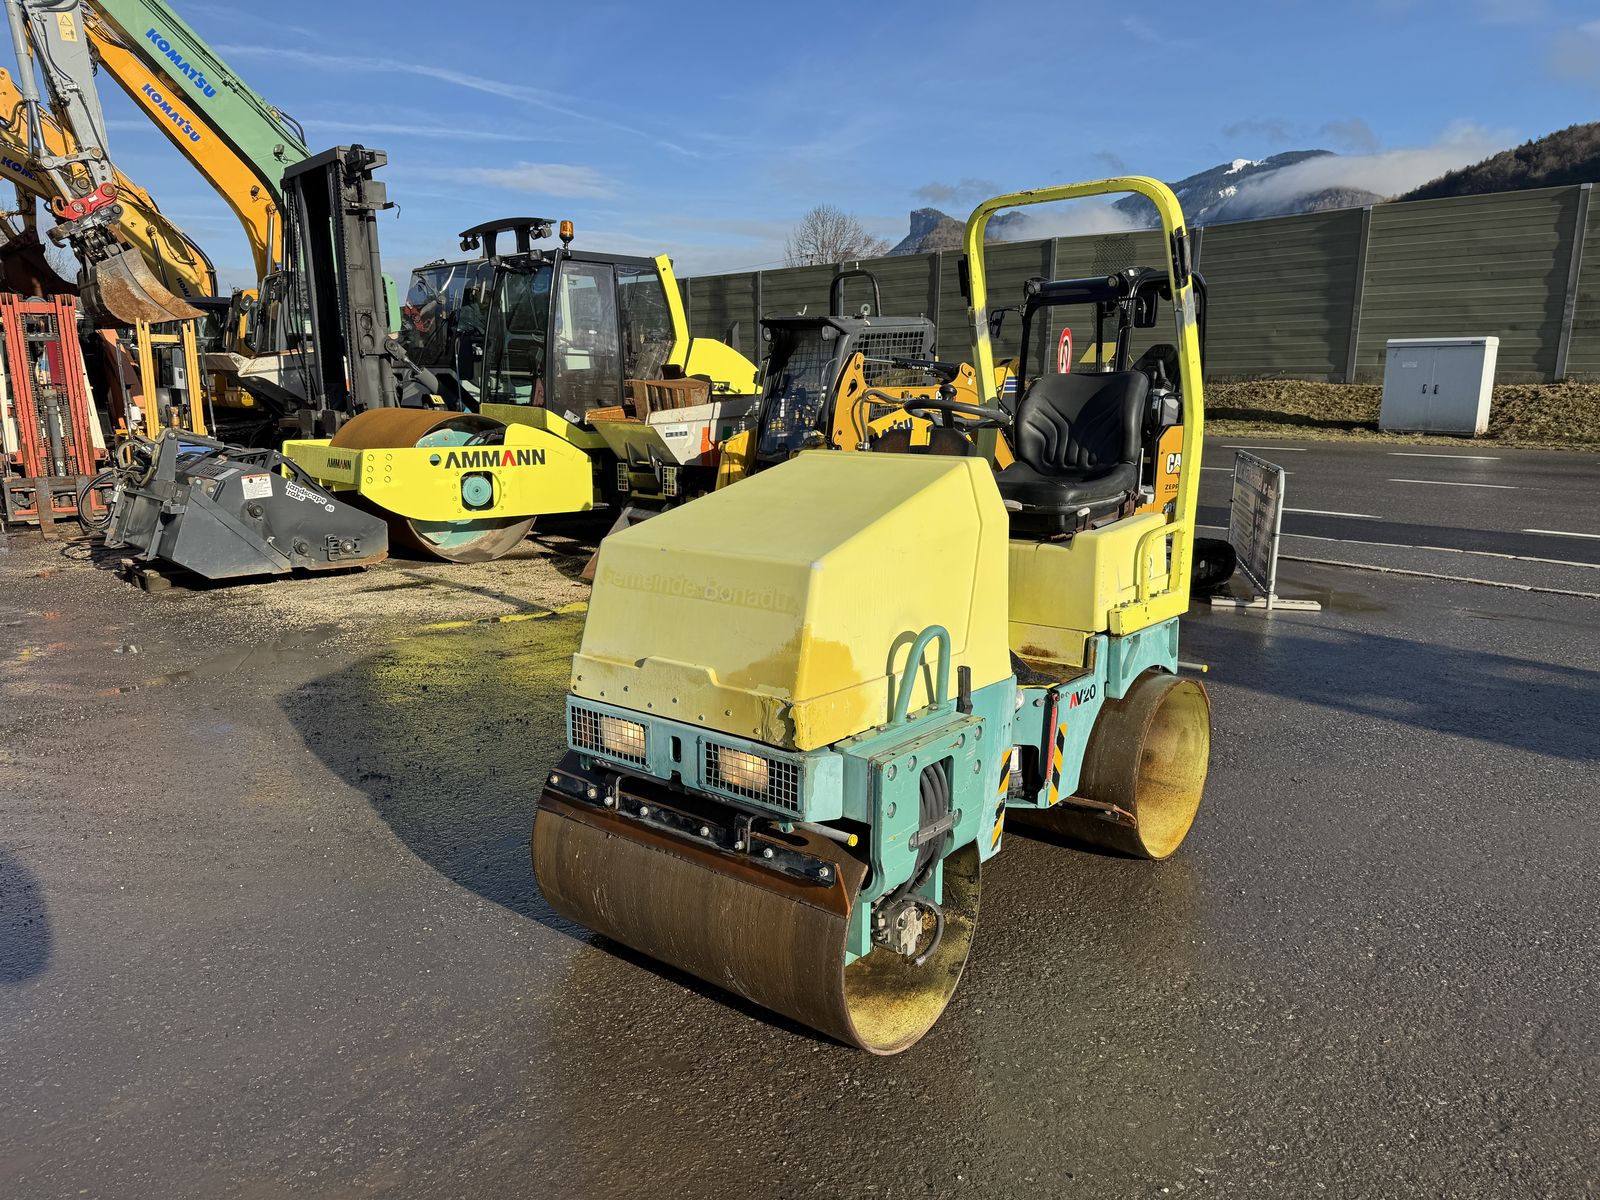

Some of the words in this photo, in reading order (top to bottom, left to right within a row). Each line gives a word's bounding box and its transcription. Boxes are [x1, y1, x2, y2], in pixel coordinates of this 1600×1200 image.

[145, 27, 217, 98] KOMATSU
[141, 83, 201, 142] KOMATSU
[1, 156, 34, 179] KOM
[176, 277, 191, 298] KOM
[327, 458, 351, 470] AMMANN
[445, 449, 546, 469] AMMANN
[1166, 453, 1181, 474] CA
[286, 481, 327, 504] landscape
[286, 489, 306, 501] rake
[1069, 684, 1096, 710] AV20
